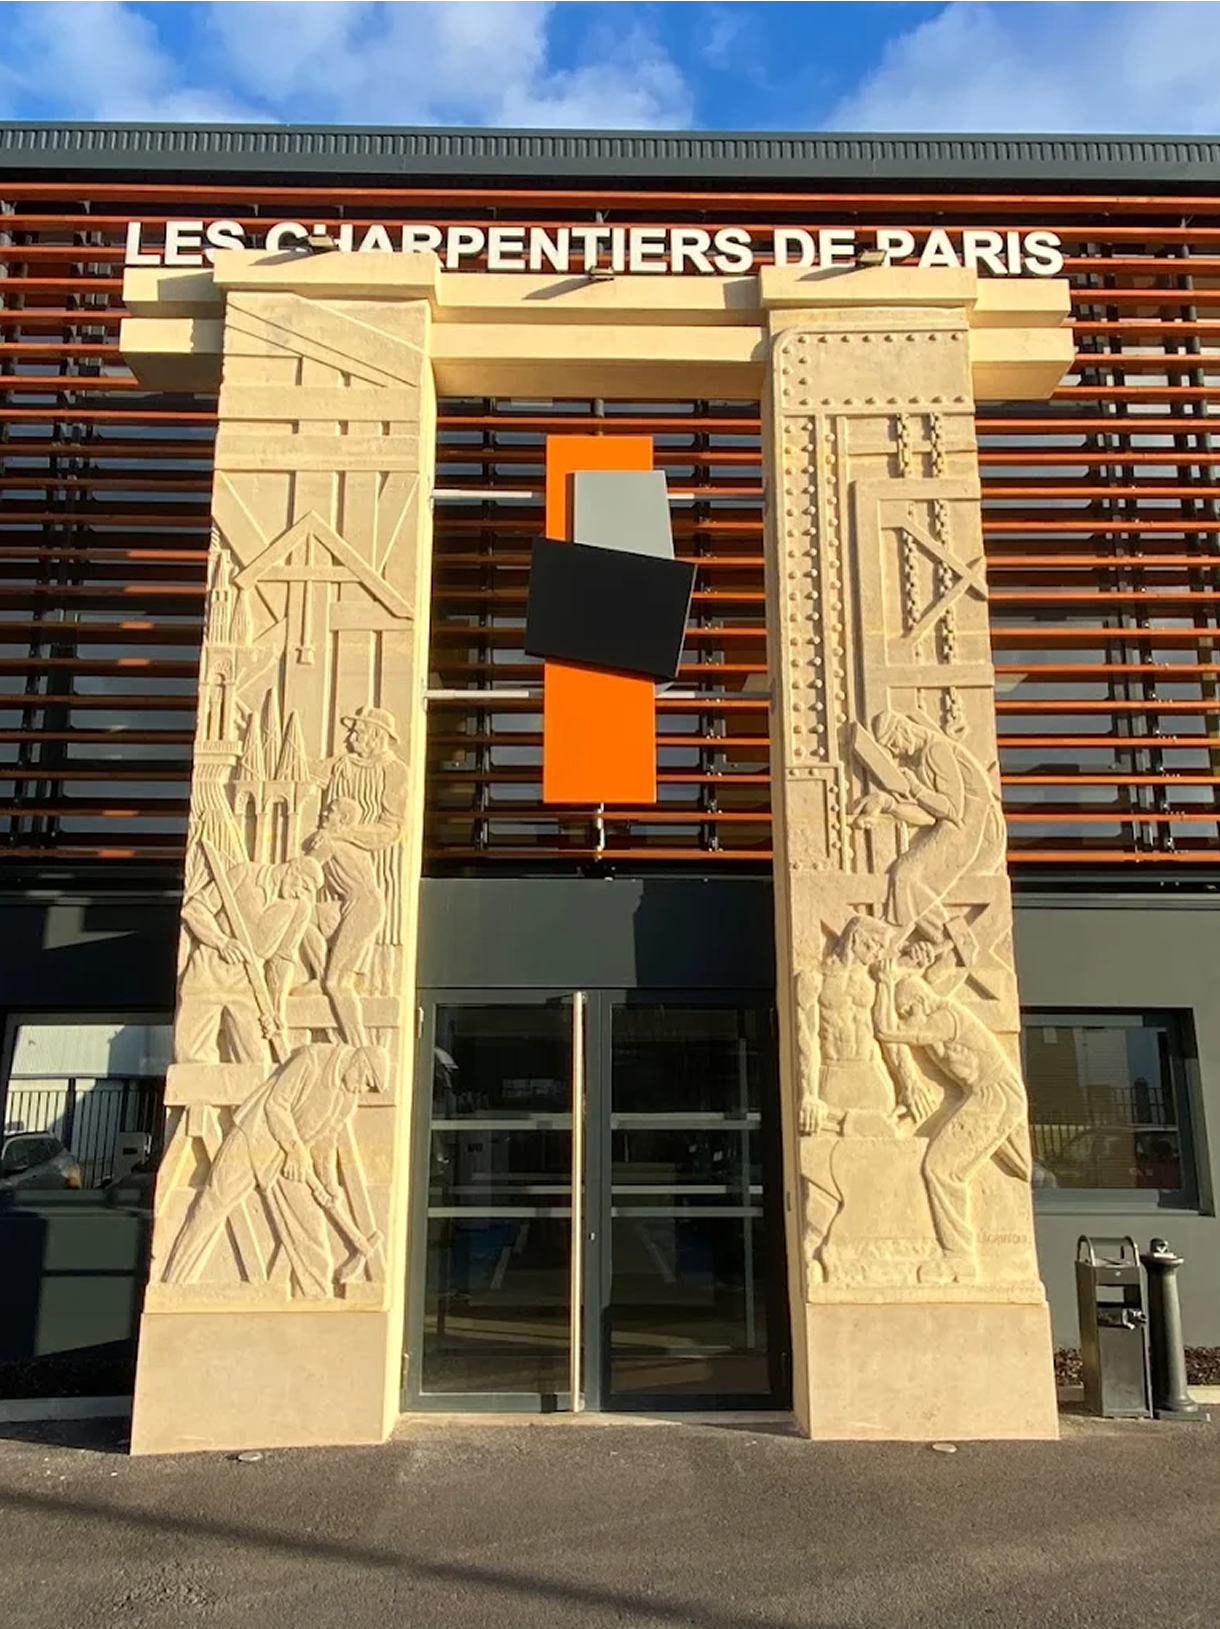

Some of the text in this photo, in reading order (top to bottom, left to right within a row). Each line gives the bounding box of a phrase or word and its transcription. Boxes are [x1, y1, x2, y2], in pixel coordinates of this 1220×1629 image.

[125, 220, 246, 265] LES
[774, 229, 856, 268] DE
[877, 229, 1064, 275] PARIS
